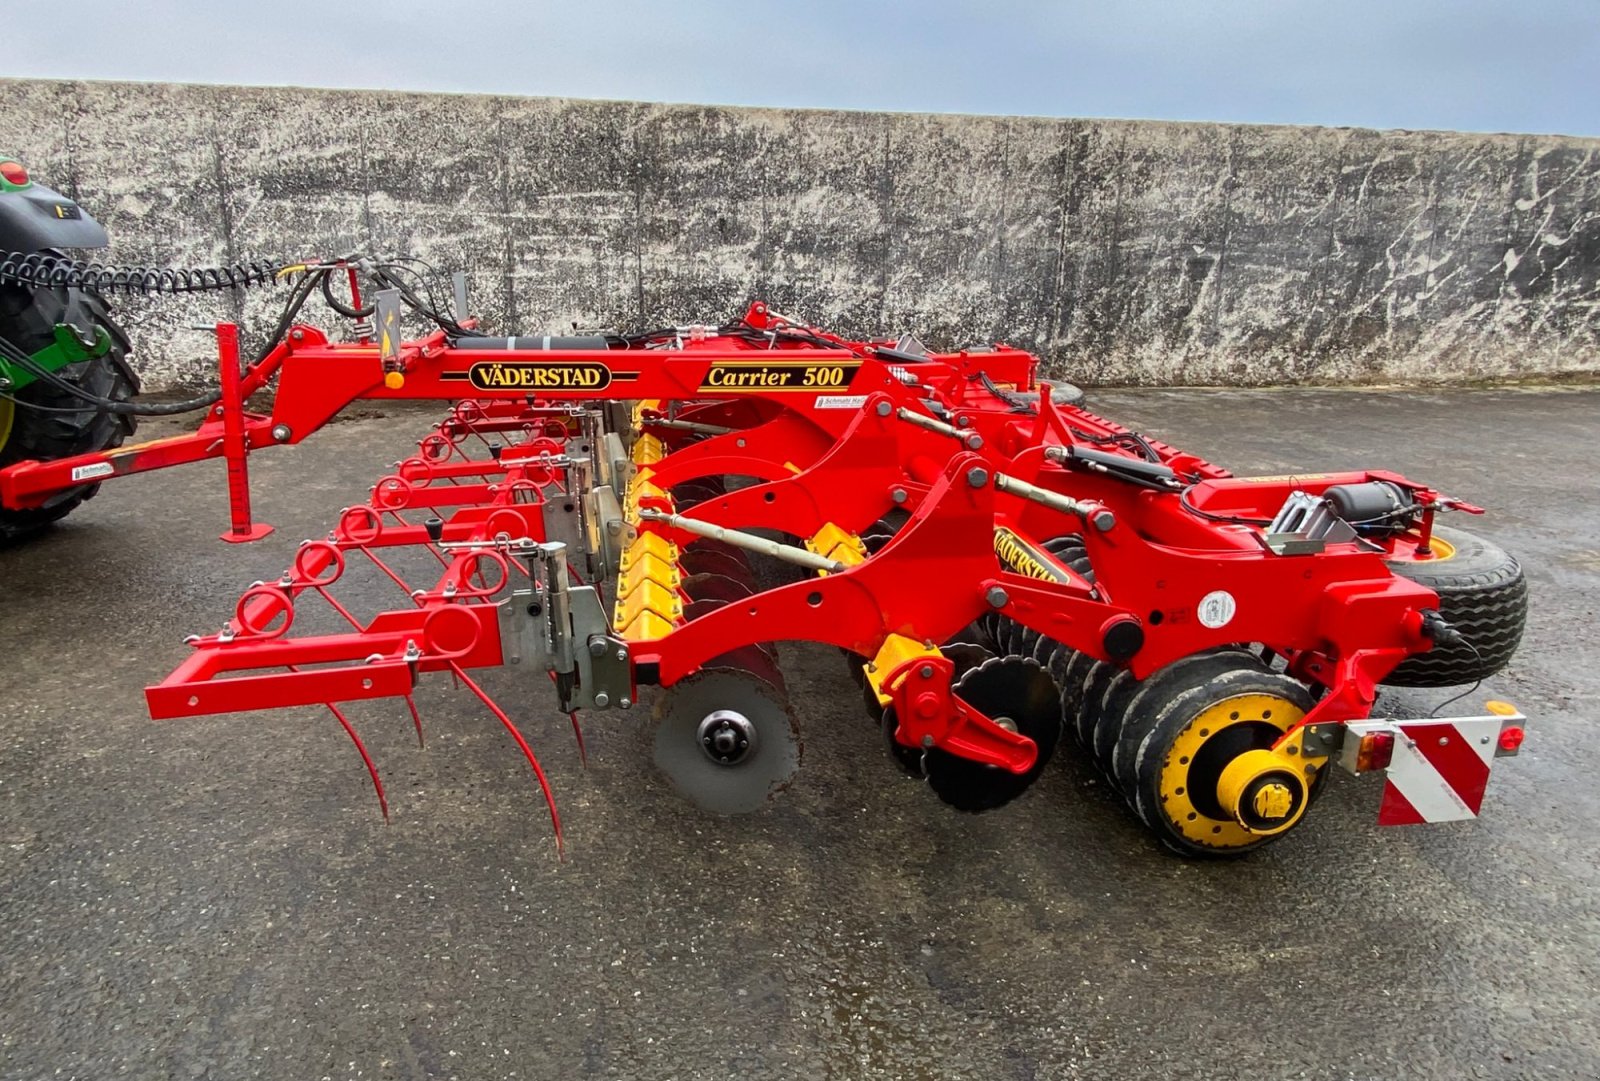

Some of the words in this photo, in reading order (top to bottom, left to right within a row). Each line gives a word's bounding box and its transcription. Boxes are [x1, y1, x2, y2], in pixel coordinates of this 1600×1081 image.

[478, 364, 601, 386] VÄDERSTAD
[708, 367, 791, 386] Carrier
[802, 367, 844, 386] 500
